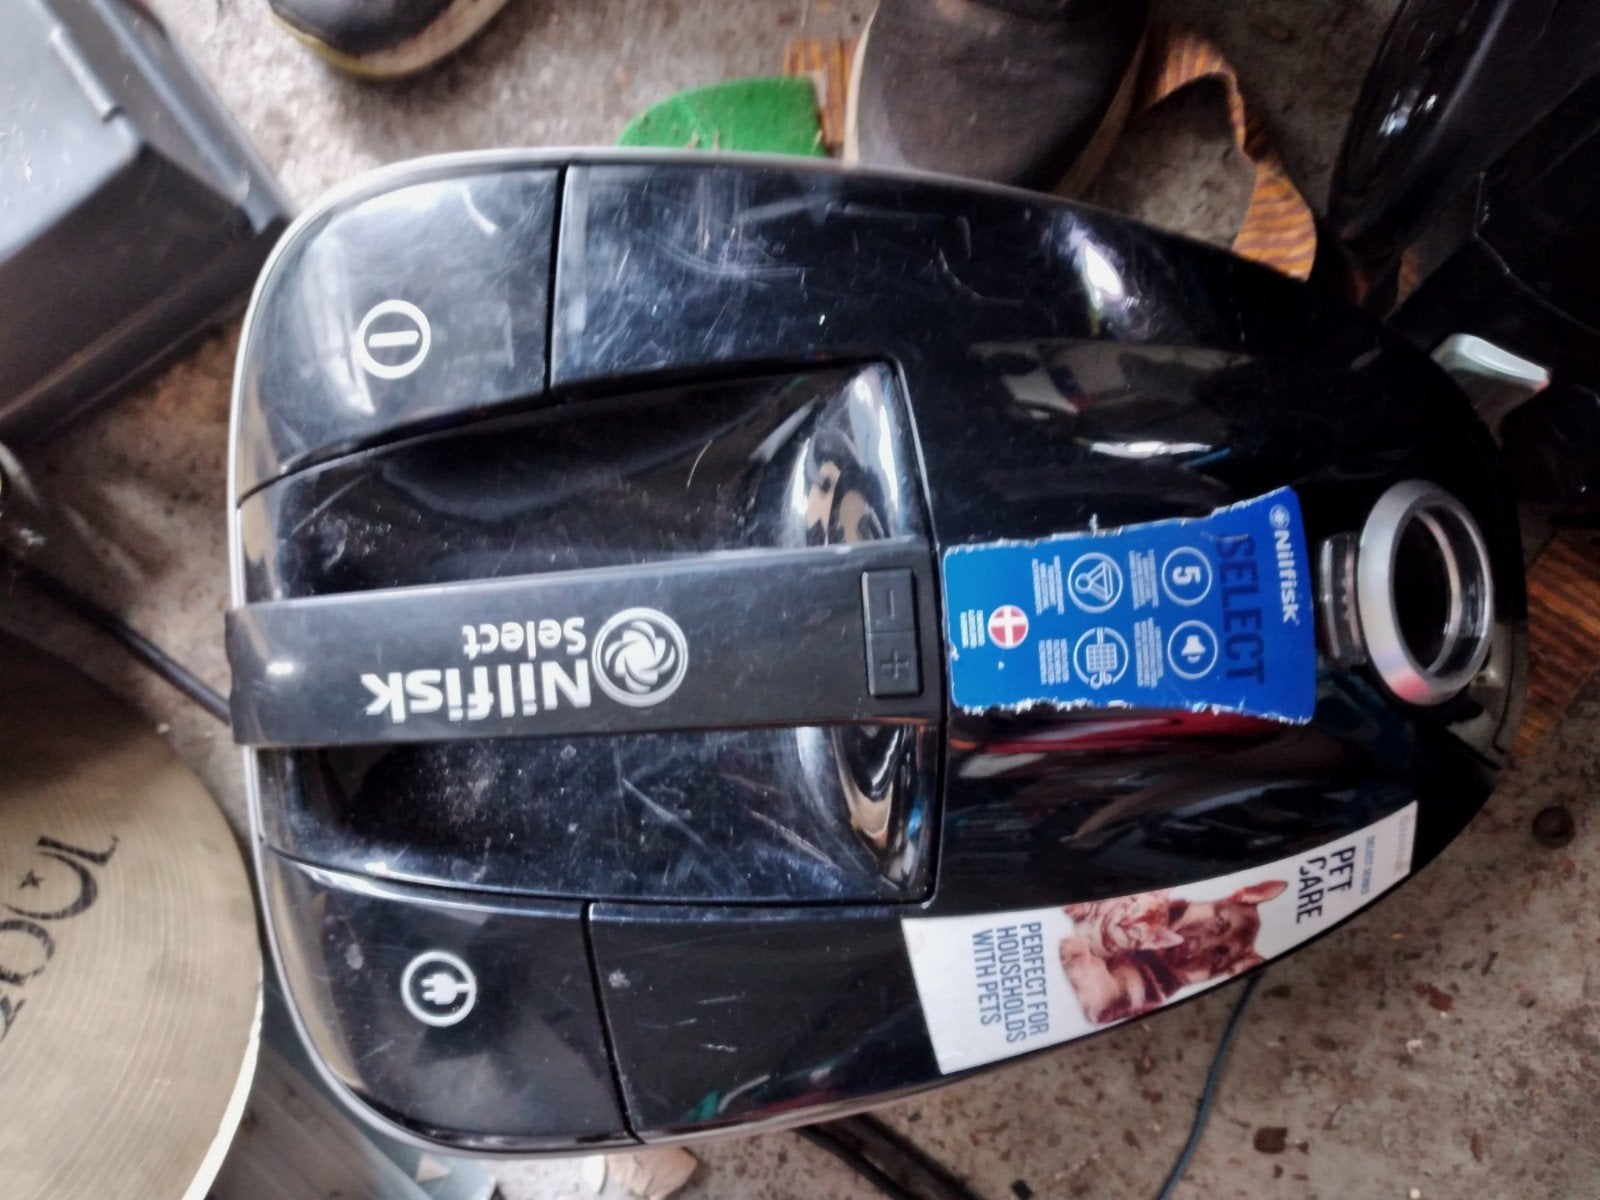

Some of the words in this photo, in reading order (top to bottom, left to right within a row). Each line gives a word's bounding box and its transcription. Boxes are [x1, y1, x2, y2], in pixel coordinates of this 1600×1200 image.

[1172, 566, 1201, 586] 5
[1274, 529, 1299, 623] Nilfisk
[1215, 533, 1266, 685] SELECT
[461, 617, 587, 661] Select
[361, 658, 591, 724] Nilfisk
[1296, 856, 1328, 924] CARE
[1327, 846, 1356, 892] PET
[972, 928, 998, 978] WITH
[1020, 921, 1047, 997] PERFECT
[977, 980, 1002, 1026] PETS
[996, 925, 1027, 1043] HOUSEHOLDS
[1027, 1000, 1050, 1036] FOR
